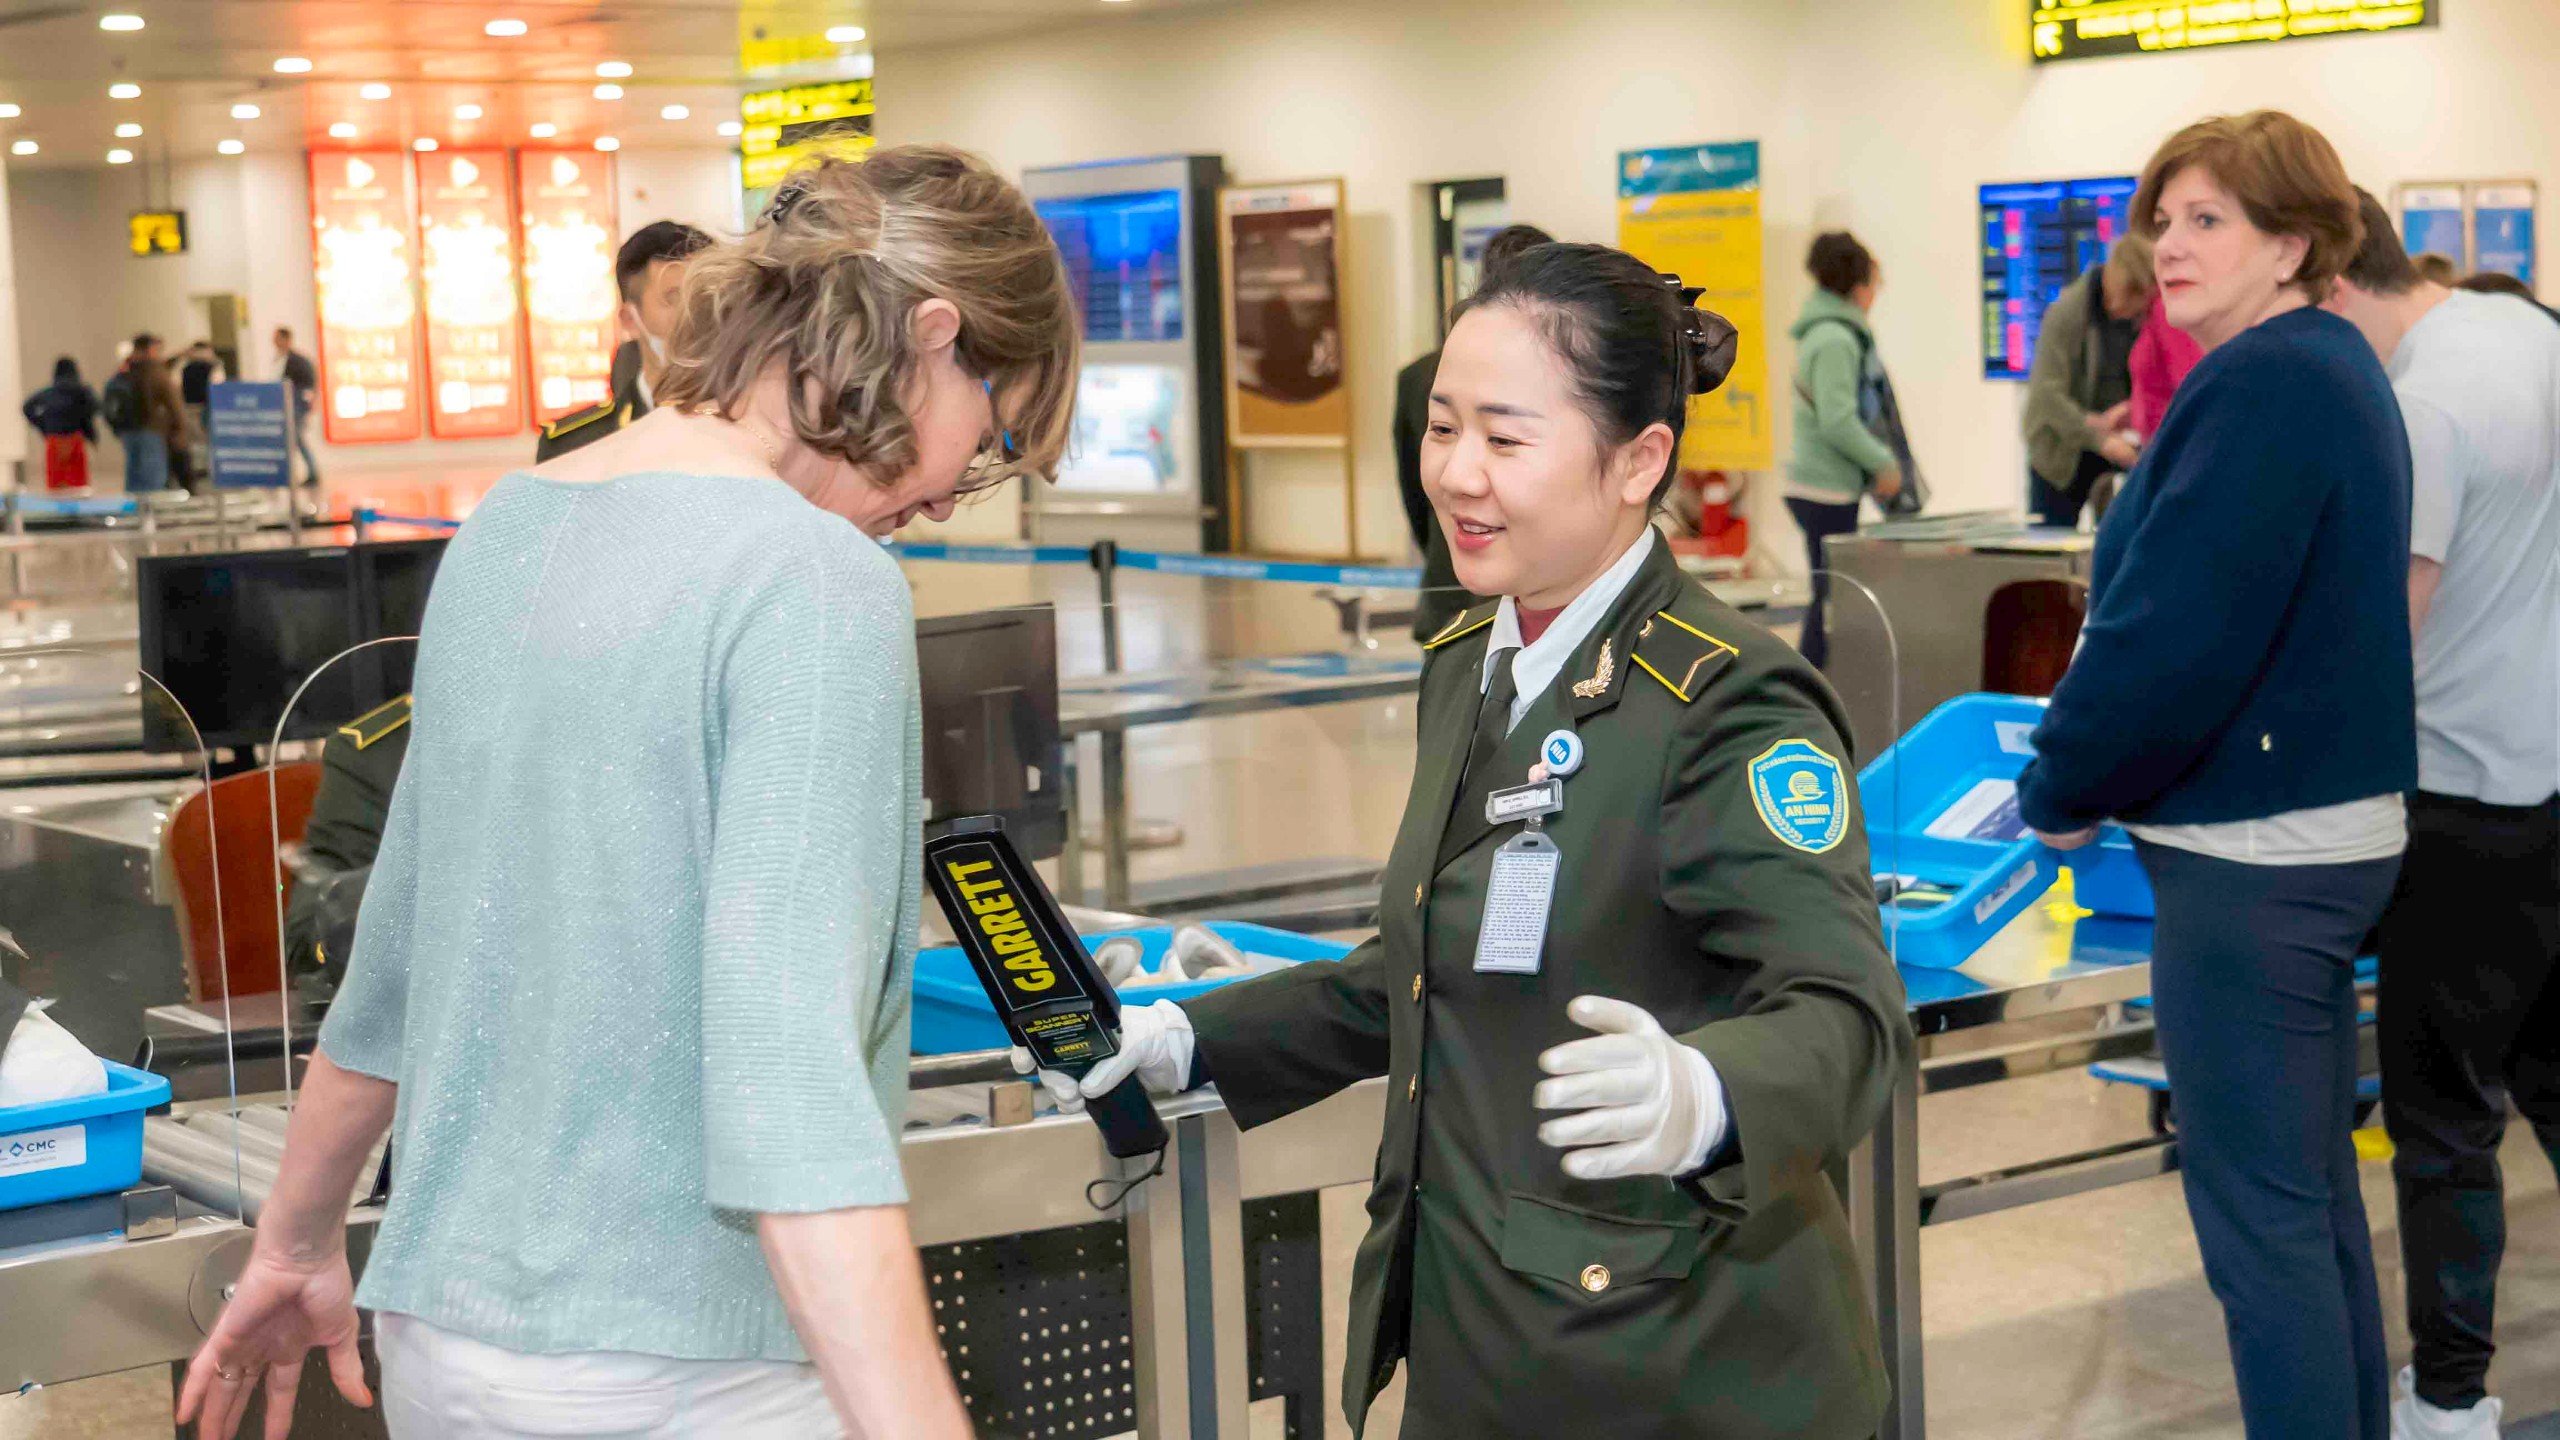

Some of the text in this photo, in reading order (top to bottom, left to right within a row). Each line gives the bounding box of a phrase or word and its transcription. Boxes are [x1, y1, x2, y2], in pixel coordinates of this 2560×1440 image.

[1549, 741, 1568, 763] NIA
[1785, 804, 1831, 817] AN NINH
[1795, 817, 1825, 825] SECURITY
[946, 860, 1057, 993] GARRETT
[1025, 1018, 1082, 1034] SCANNER
[1032, 1013, 1078, 1026] SUPER
[1054, 1041, 1090, 1054] GARRETT
[26, 1139, 57, 1153] CMC
